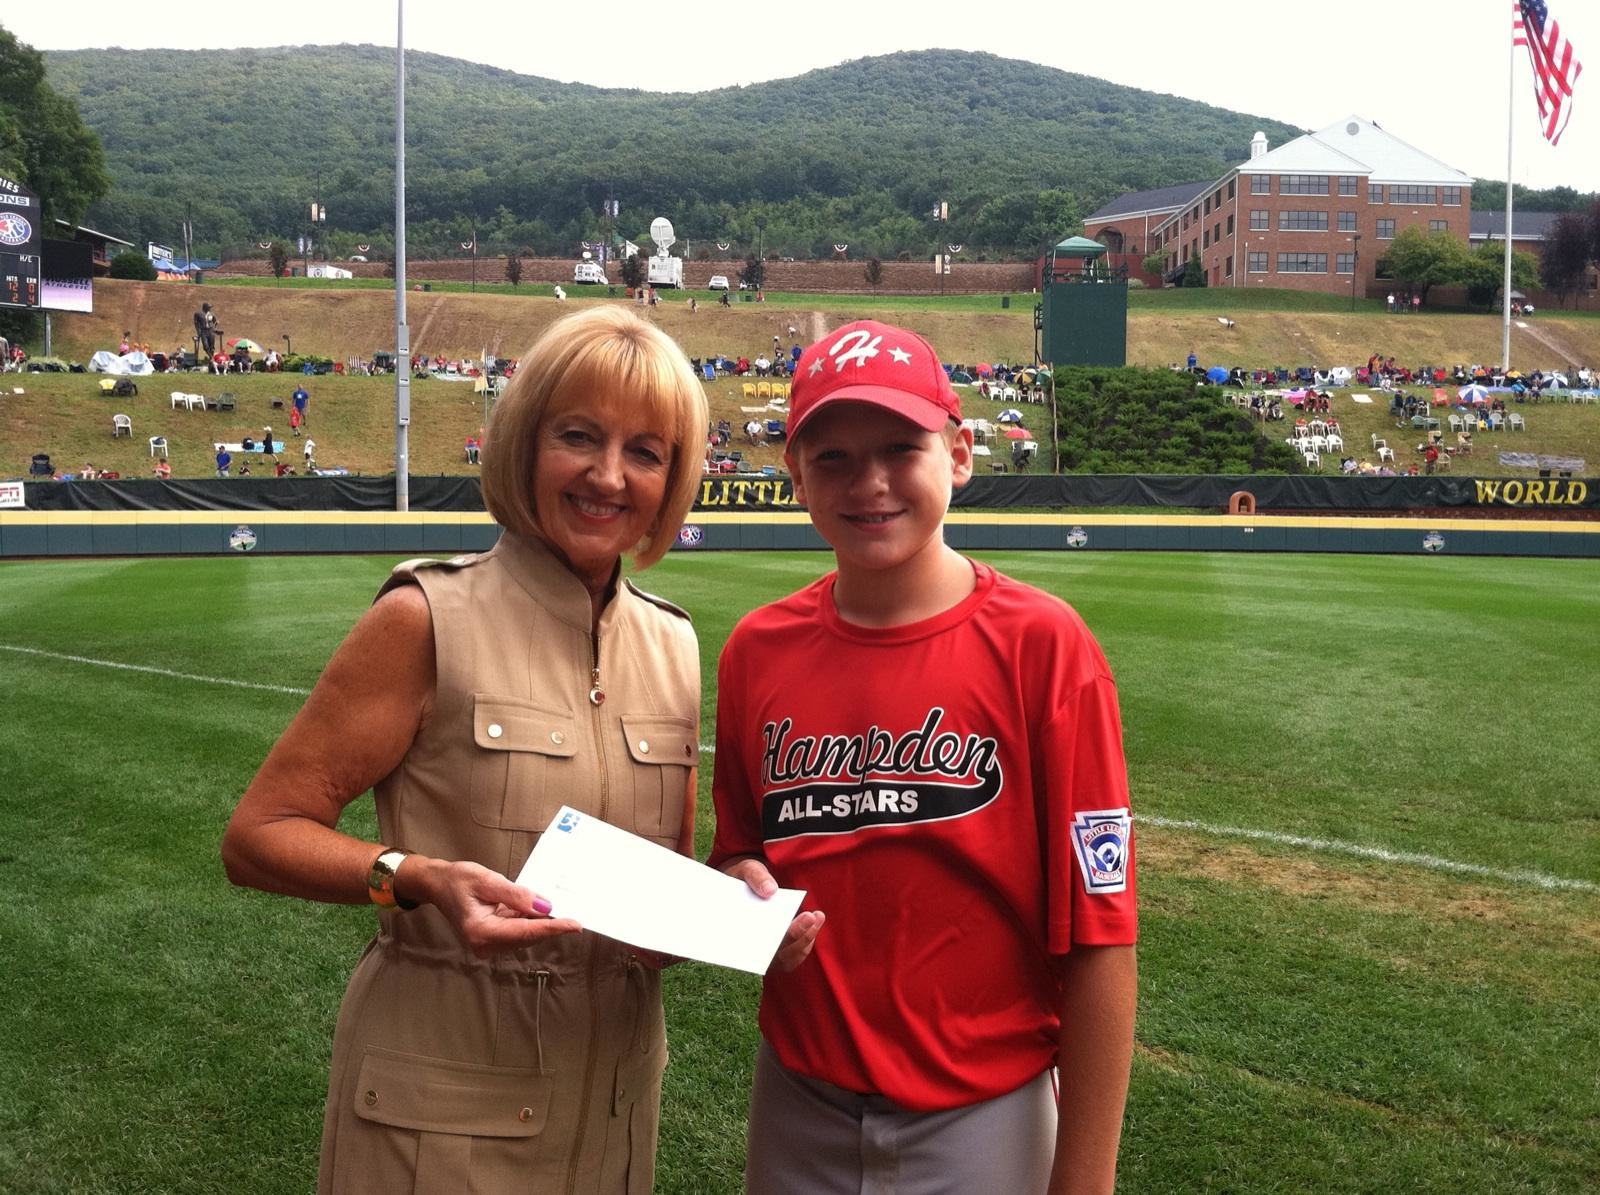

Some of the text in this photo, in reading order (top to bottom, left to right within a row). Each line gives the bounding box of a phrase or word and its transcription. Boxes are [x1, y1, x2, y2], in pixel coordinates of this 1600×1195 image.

[701, 480, 1587, 506] LITTL WORLD
[762, 707, 1000, 789] Hampden
[778, 790, 919, 823] ALL-STARS
